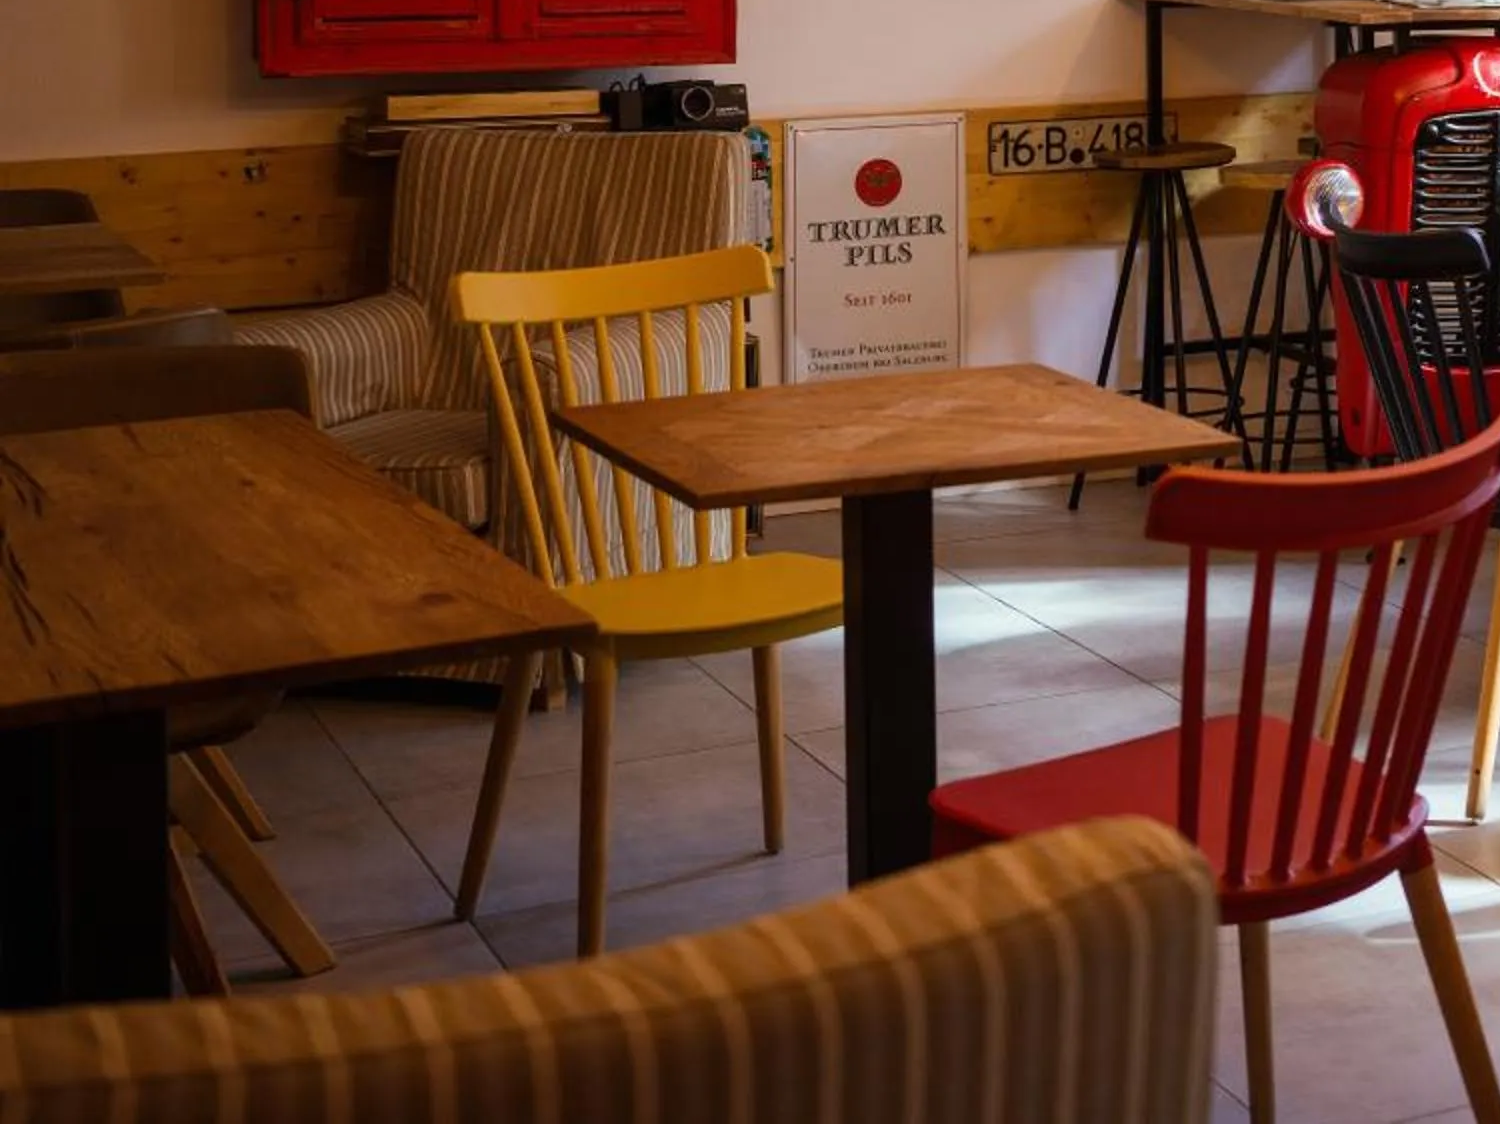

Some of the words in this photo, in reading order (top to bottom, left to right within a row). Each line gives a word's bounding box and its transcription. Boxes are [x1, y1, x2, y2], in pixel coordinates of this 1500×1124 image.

[808, 214, 946, 243] TRUMER
[844, 242, 913, 267] PILS
[881, 292, 912, 306] 1601
